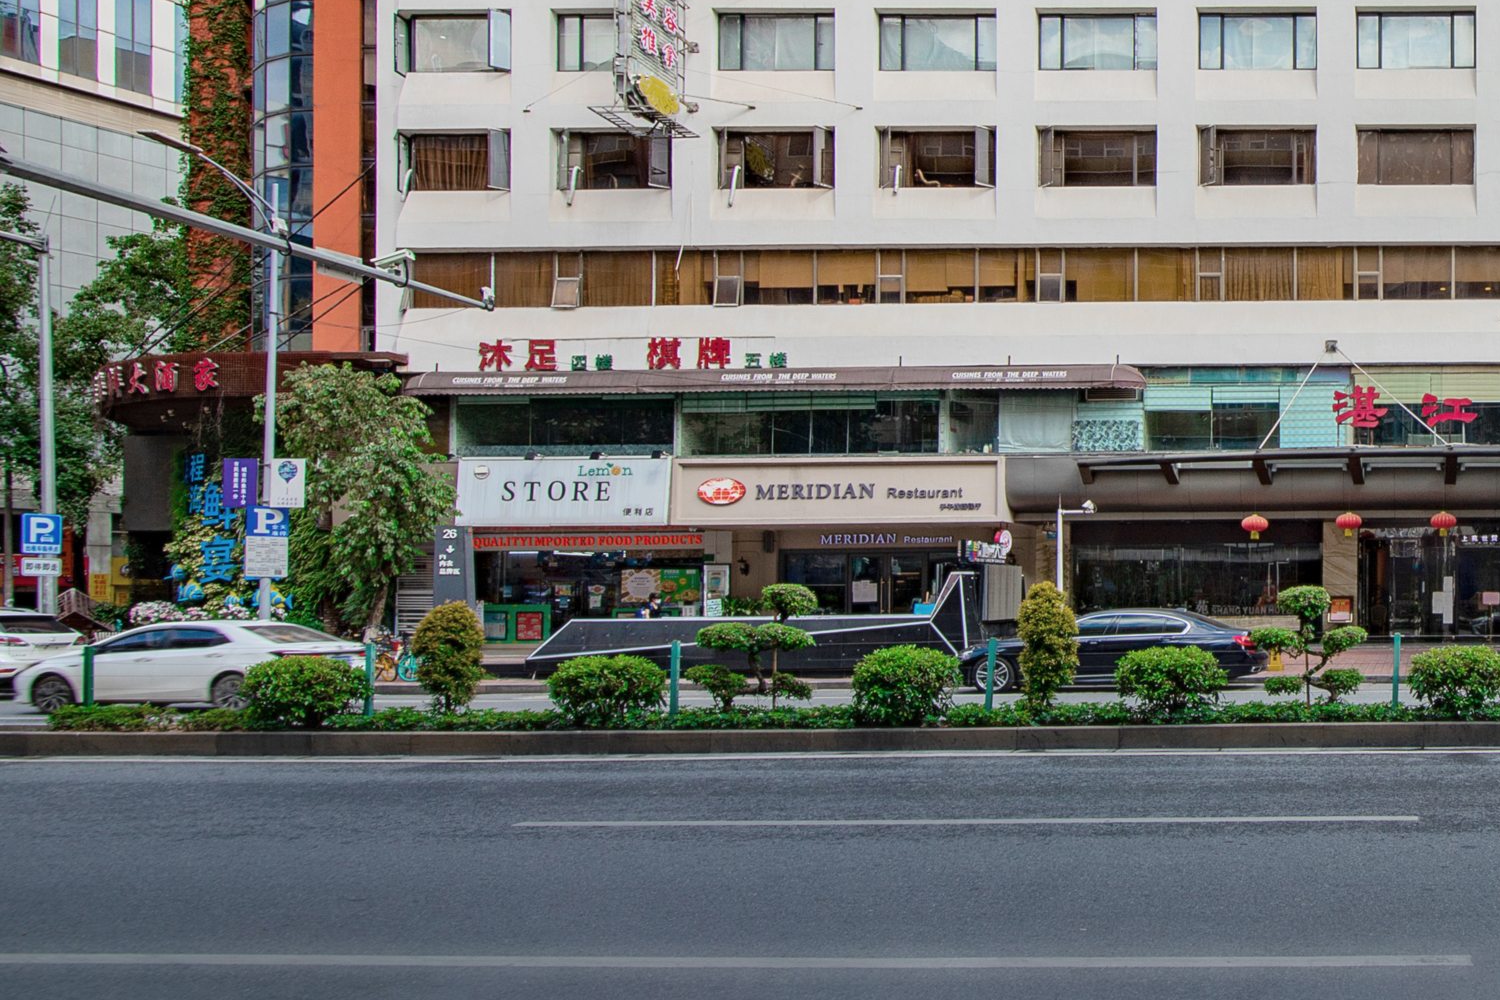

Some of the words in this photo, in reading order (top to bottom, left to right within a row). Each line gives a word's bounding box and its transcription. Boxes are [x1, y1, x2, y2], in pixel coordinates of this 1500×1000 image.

[640, 26, 678, 69] 推拿
[478, 339, 560, 371] 沐足
[571, 353, 614, 370] 四楼
[646, 337, 731, 369] 棋牌
[744, 352, 788, 368] 五楼
[1332, 385, 1478, 428] 湛江
[578, 463, 633, 477] Lemon
[501, 481, 611, 501] STORE
[755, 483, 875, 500] MERIDIAN
[887, 487, 963, 499] Restaurant
[623, 507, 654, 516] 便利店
[253, 508, 284, 534] P
[30, 517, 55, 543] P
[442, 529, 457, 539] 26
[597, 535, 632, 546] FOOD
[634, 534, 703, 545] PRODUCTS
[820, 534, 897, 546] MERIDIAN
[904, 535, 954, 544] Restaurant
[25, 562, 59, 572] 即停即走
[1211, 605, 1240, 615] SHANG
[1242, 605, 1267, 615] YUAN
[1268, 605, 1292, 614] HOTE
